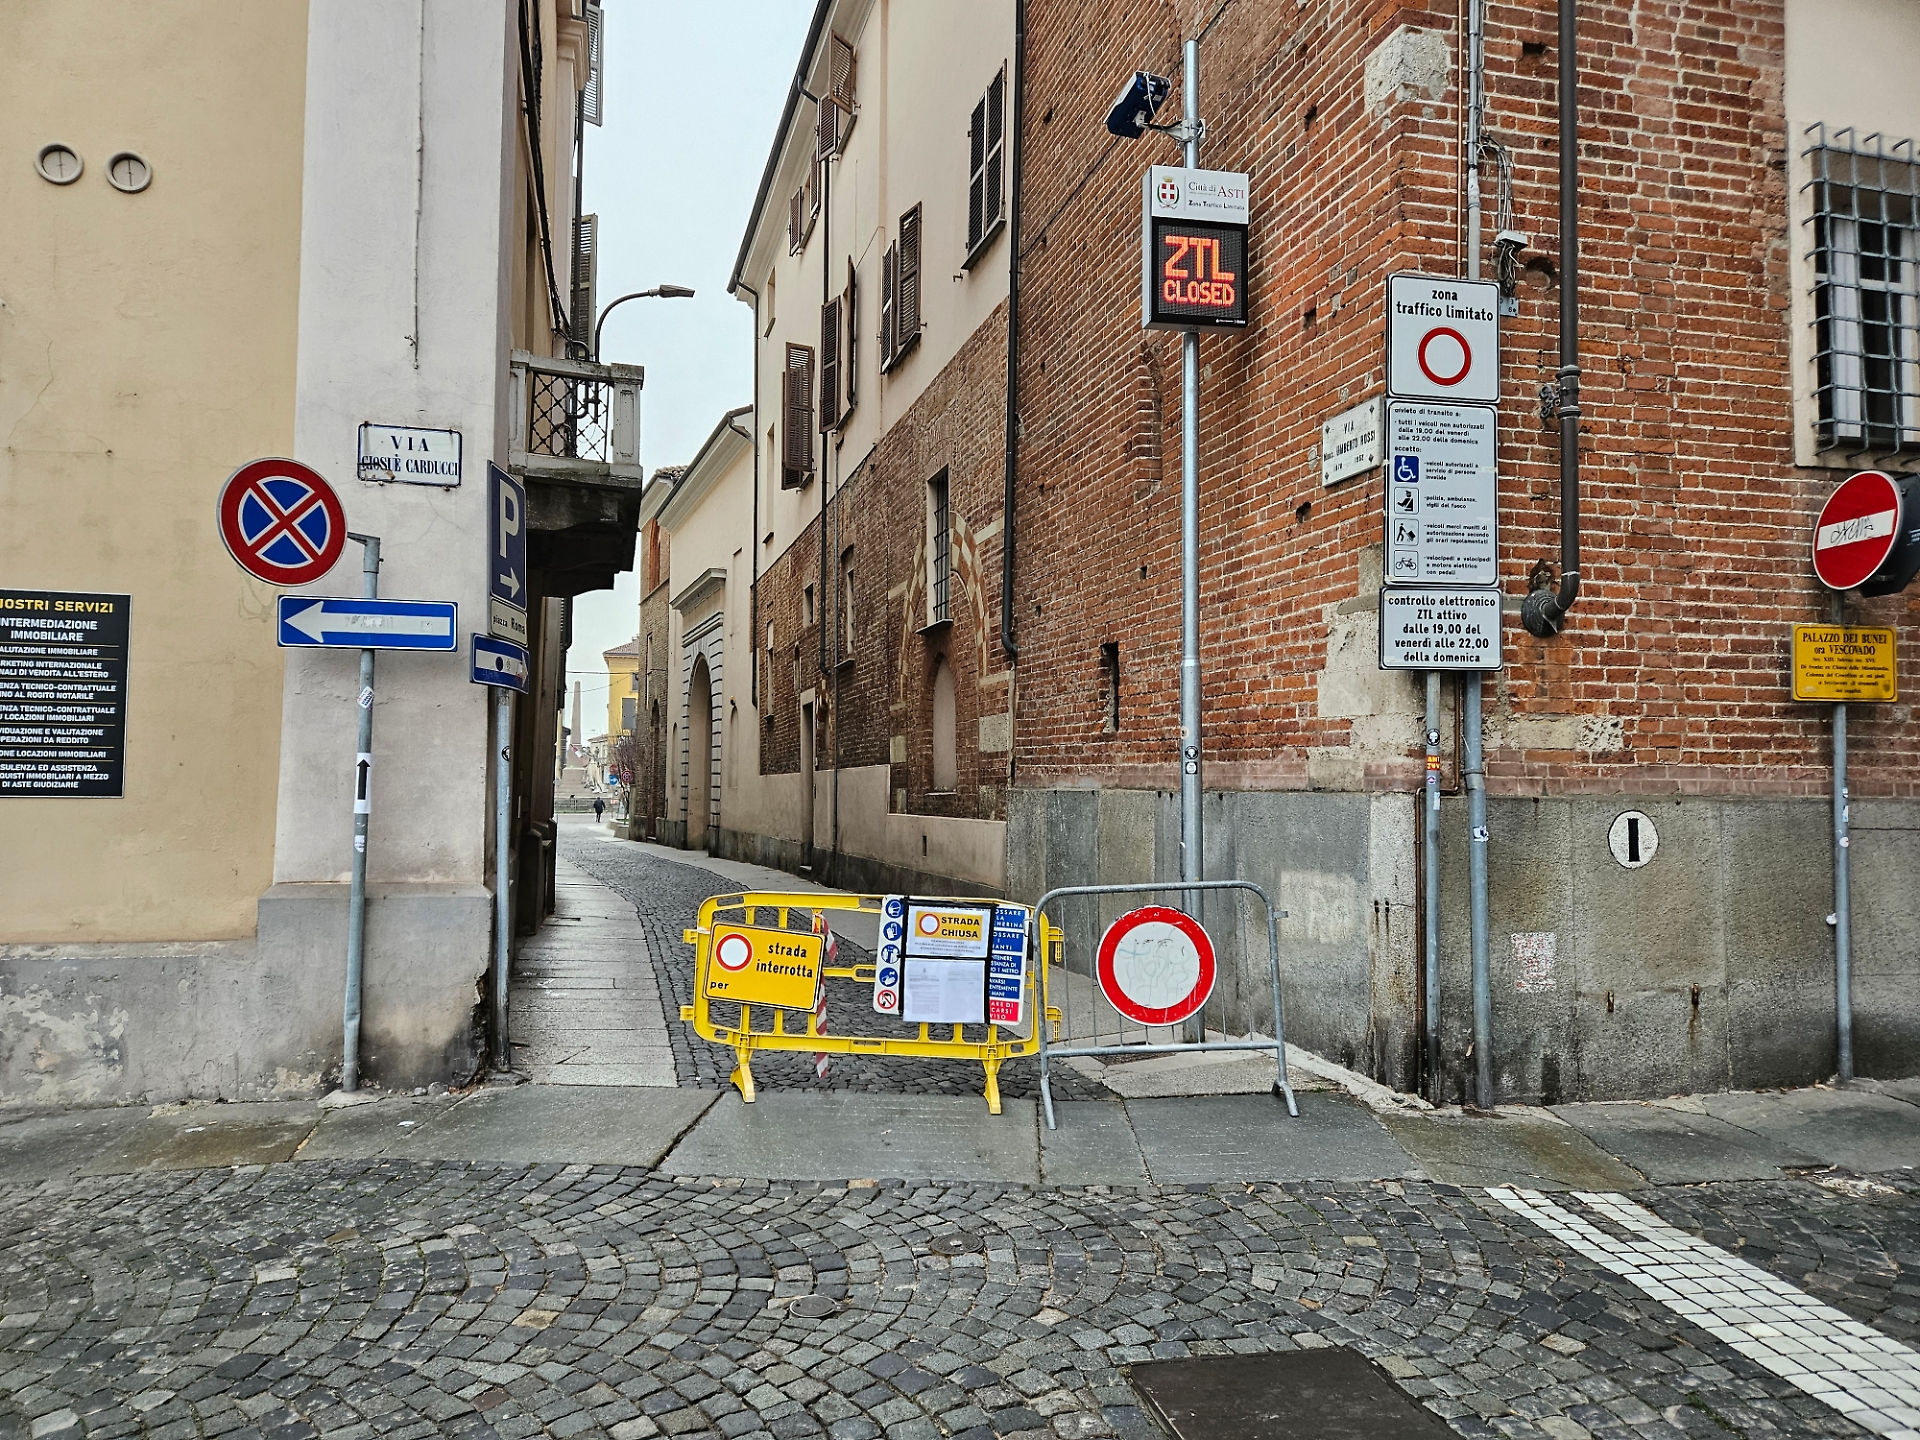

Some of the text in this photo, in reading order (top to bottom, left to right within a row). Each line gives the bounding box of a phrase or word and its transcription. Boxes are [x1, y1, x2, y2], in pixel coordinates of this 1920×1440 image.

[1188, 181, 1207, 192] Città
[1217, 186, 1245, 199] ASTI
[1165, 235, 1235, 282] ZTL
[1163, 279, 1235, 307] CLOSED
[1432, 290, 1458, 301] zona
[1396, 301, 1442, 317] traffico
[1446, 305, 1494, 321] limitato
[1427, 409, 1453, 417] transito
[1343, 420, 1354, 435] VIA
[1453, 422, 1485, 430] autorizzati
[391, 435, 430, 453] VIA
[1360, 430, 1376, 446] ROSSI
[1394, 445, 1422, 453] eccetto:
[405, 458, 459, 477] CARDUCCI
[499, 478, 520, 559] P
[54, 600, 114, 614] SERVIZI
[1388, 595, 1496, 607] controllo elettronico
[1417, 609, 1468, 620] ZTL attivo
[492, 614, 526, 636] piazza Roma
[1403, 623, 1429, 634] dalle
[1465, 624, 1481, 635] del
[10, 630, 84, 642] IMMOBILIARE
[1802, 632, 1840, 643] PALAZZO
[1843, 633, 1858, 644] DEI
[1395, 637, 1431, 648] venerdì
[1434, 637, 1455, 648] alle
[48, 647, 99, 656] IMMOBILIARE
[1829, 644, 1876, 656] VESCOVADO
[1403, 651, 1481, 663] della domenica
[35, 661, 103, 670] INTERNAZIONALE
[28, 669, 61, 677] VENDITA
[62, 671, 109, 679] ALL'ESTERO
[21, 683, 117, 692] TECNICO-CONTRATTUALE
[56, 692, 94, 700] NOTARILE
[20, 705, 116, 714] TECNICO-CONTRATTUALE
[46, 714, 95, 722] IMMOBILIARI
[52, 728, 104, 736] VALUTAZIONE
[43, 736, 55, 744] DA
[941, 916, 980, 926] STRADA
[941, 928, 979, 939] CHIUSA
[768, 942, 807, 958] strada
[756, 958, 813, 978] interrotta
[710, 980, 729, 990] per
